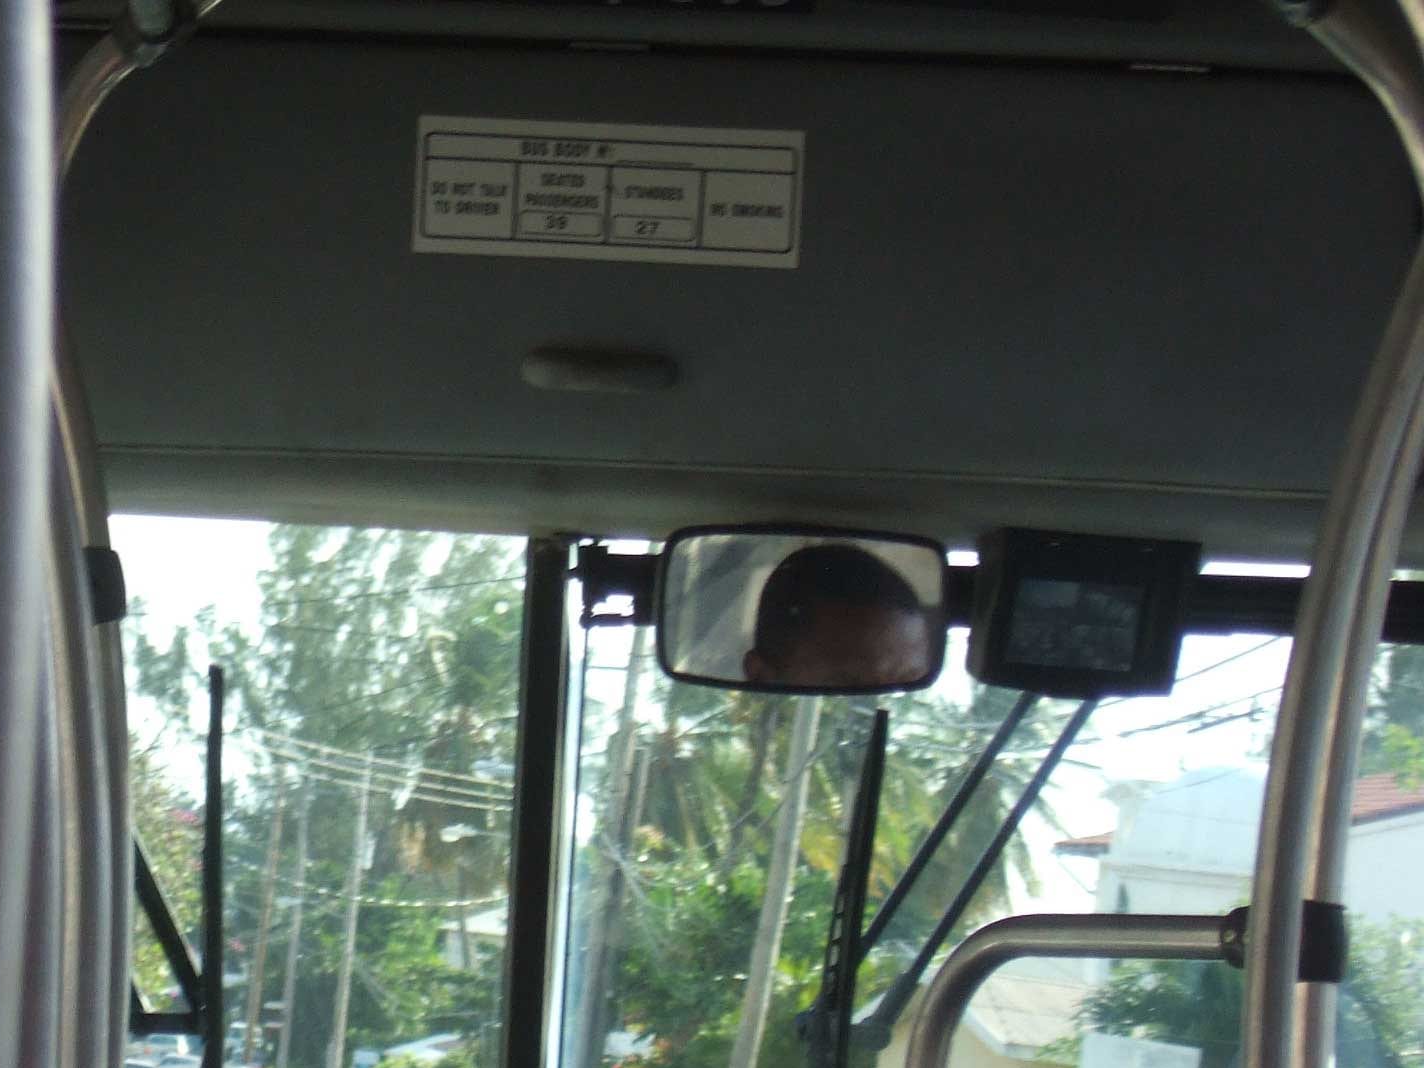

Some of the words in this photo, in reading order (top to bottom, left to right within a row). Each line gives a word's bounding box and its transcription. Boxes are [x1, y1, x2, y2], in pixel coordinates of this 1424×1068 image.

[521, 141, 548, 156] BUS
[554, 142, 590, 158] BODY
[456, 199, 500, 216] DRIVER
[634, 220, 660, 236] 27
